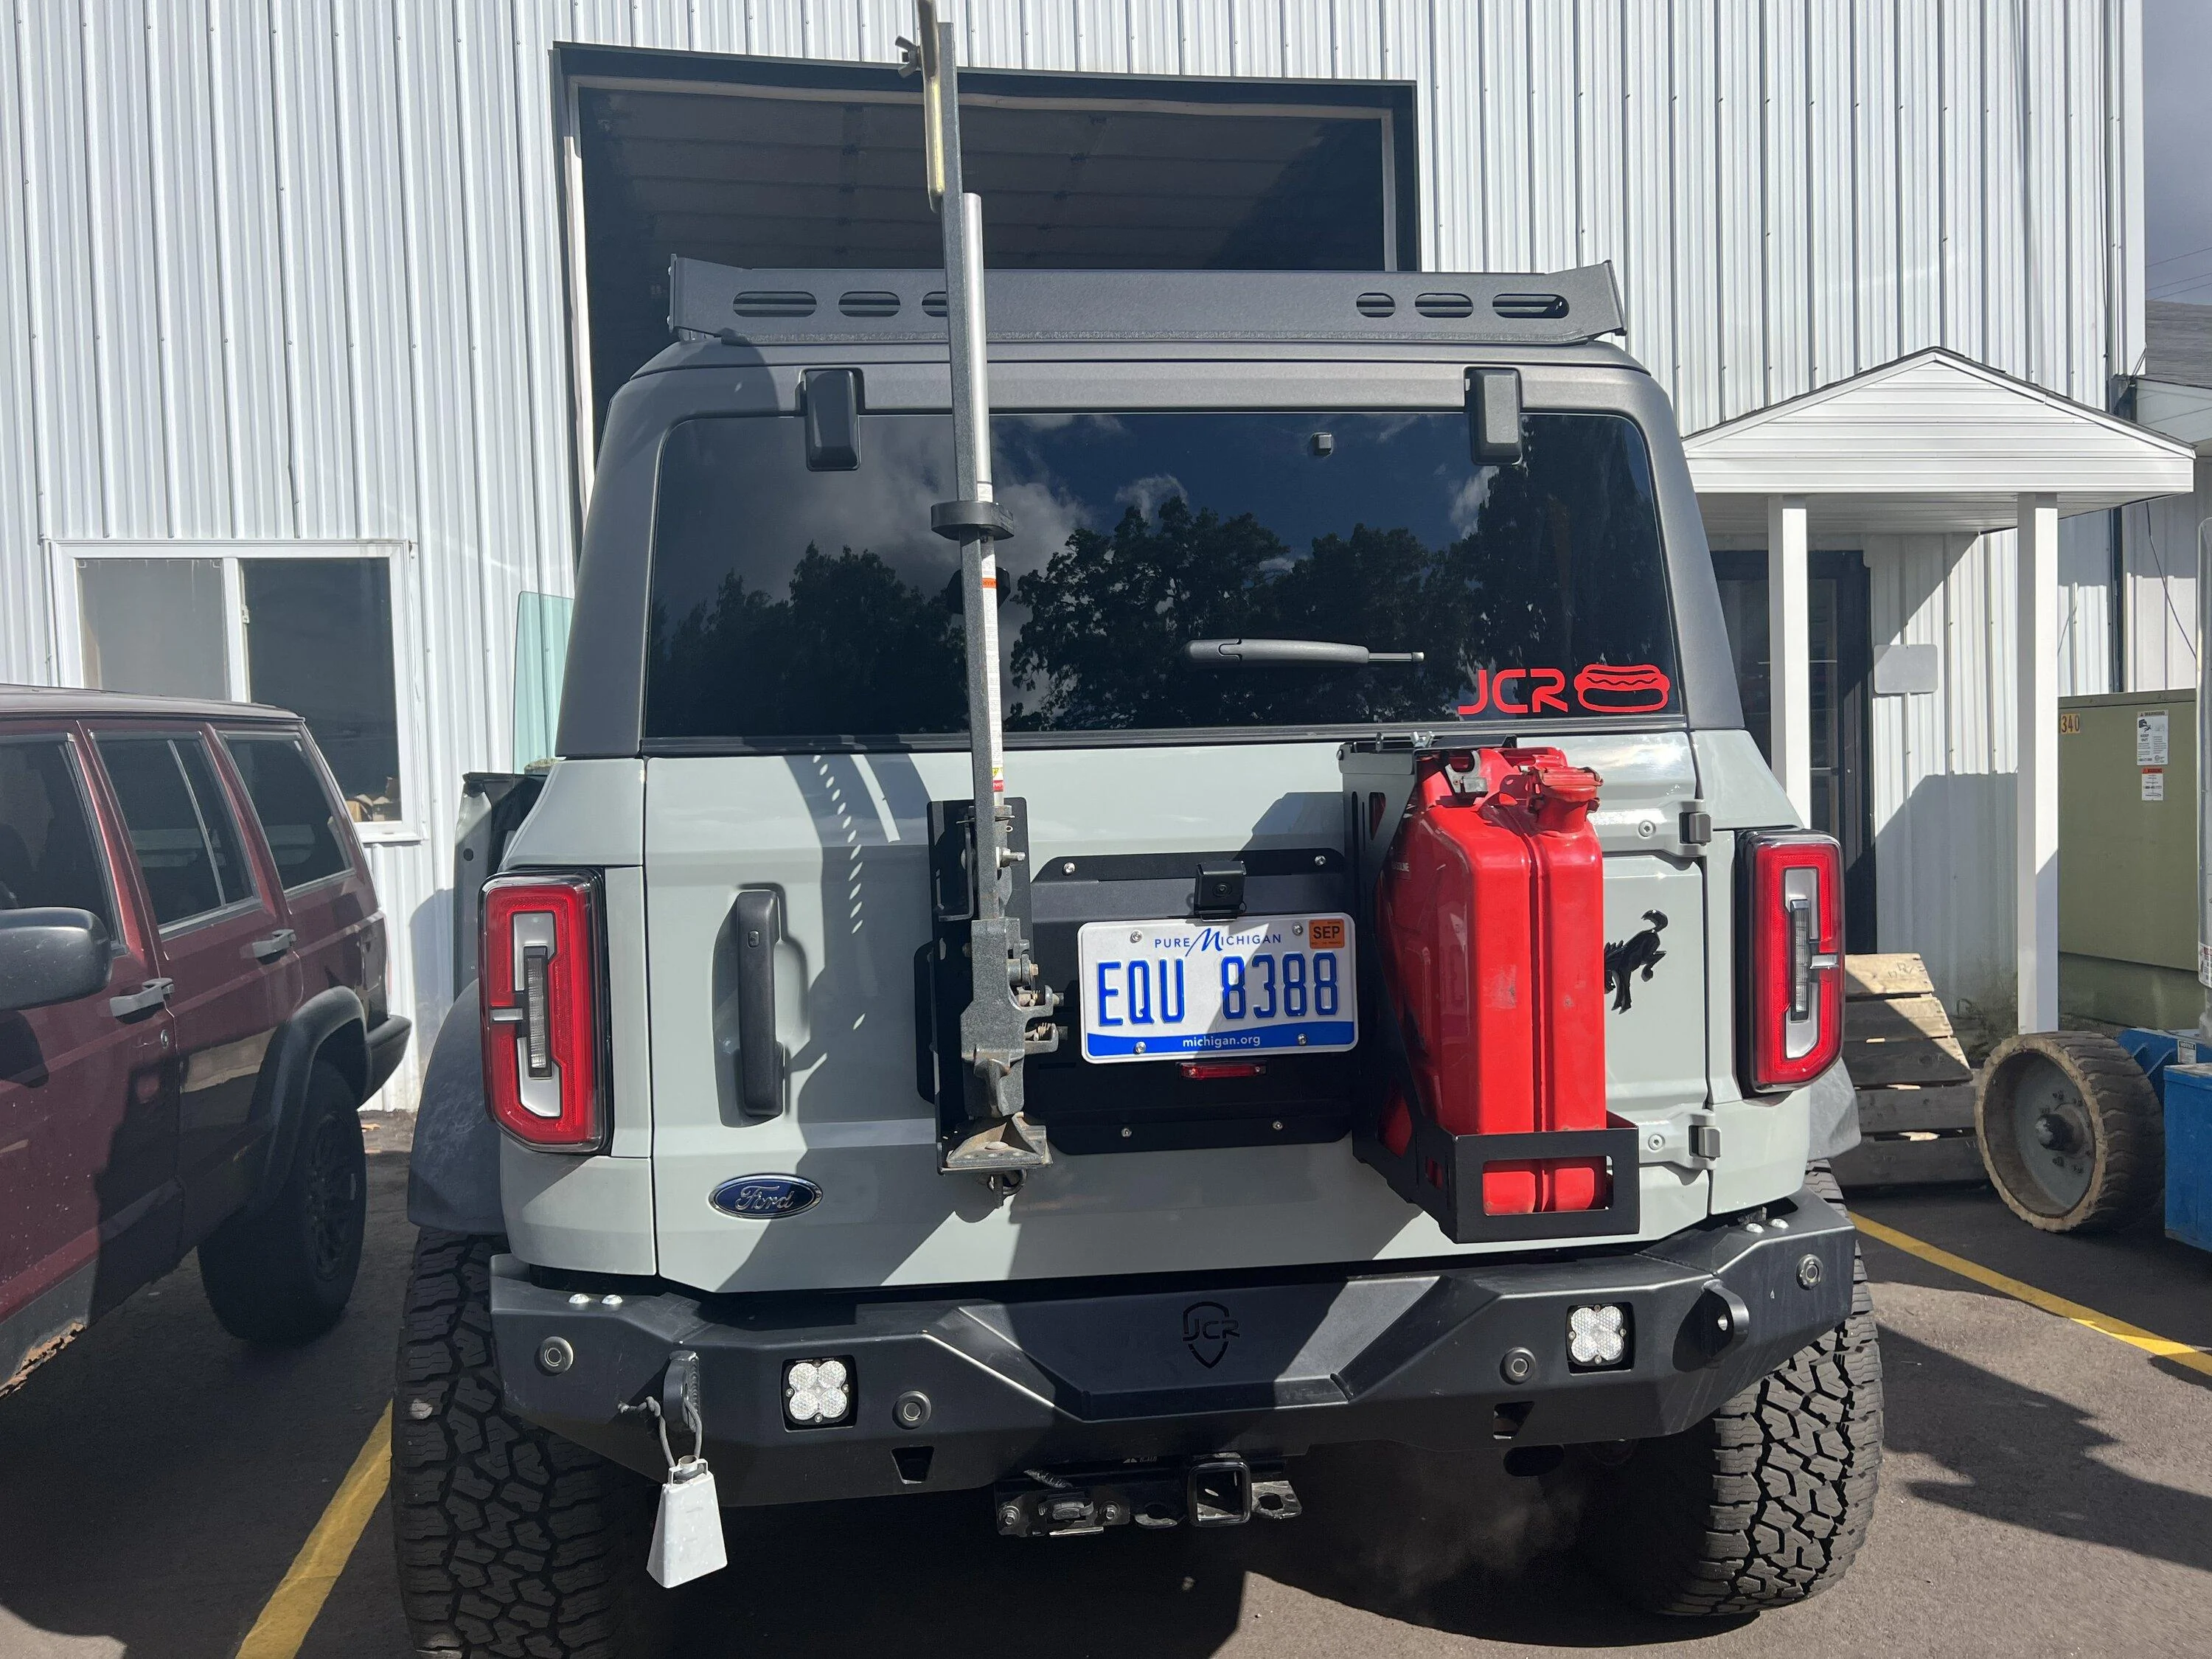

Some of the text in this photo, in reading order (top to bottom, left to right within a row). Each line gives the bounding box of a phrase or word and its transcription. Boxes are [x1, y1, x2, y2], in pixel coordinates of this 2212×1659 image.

[1457, 668, 1568, 714] JCR
[2062, 715, 2080, 733] 340
[1313, 925, 1340, 939] SEP
[1155, 938, 1190, 947] PURE
[1097, 952, 1338, 1026] EQU 8388
[1183, 1034, 1260, 1047] michigan.org
[735, 1186, 795, 1210] Ford
[1183, 1318, 1240, 1341] JCR
